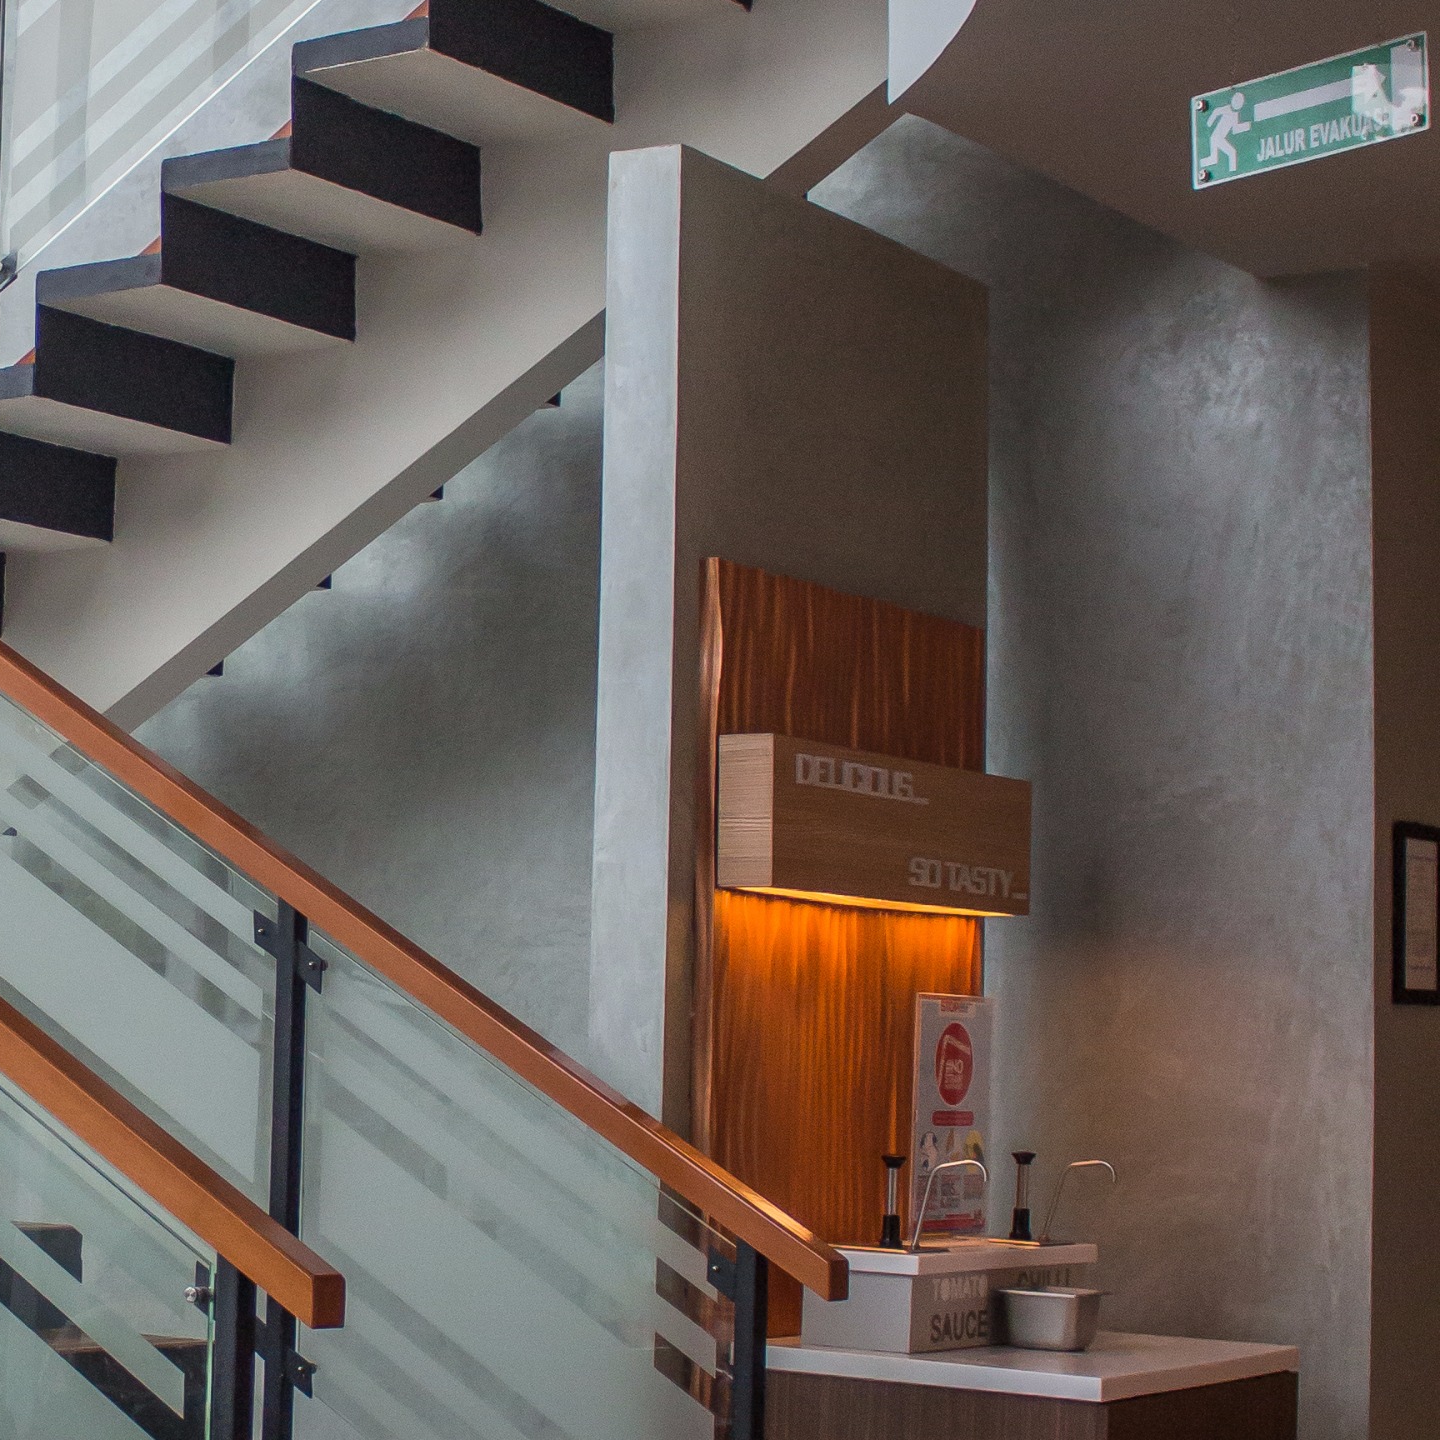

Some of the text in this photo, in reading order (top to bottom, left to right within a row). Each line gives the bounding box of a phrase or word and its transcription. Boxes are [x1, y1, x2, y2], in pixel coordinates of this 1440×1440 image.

[1257, 127, 1306, 161] JALUR
[932, 1274, 988, 1302] TOMATO
[930, 1310, 988, 1343] SAUCE
